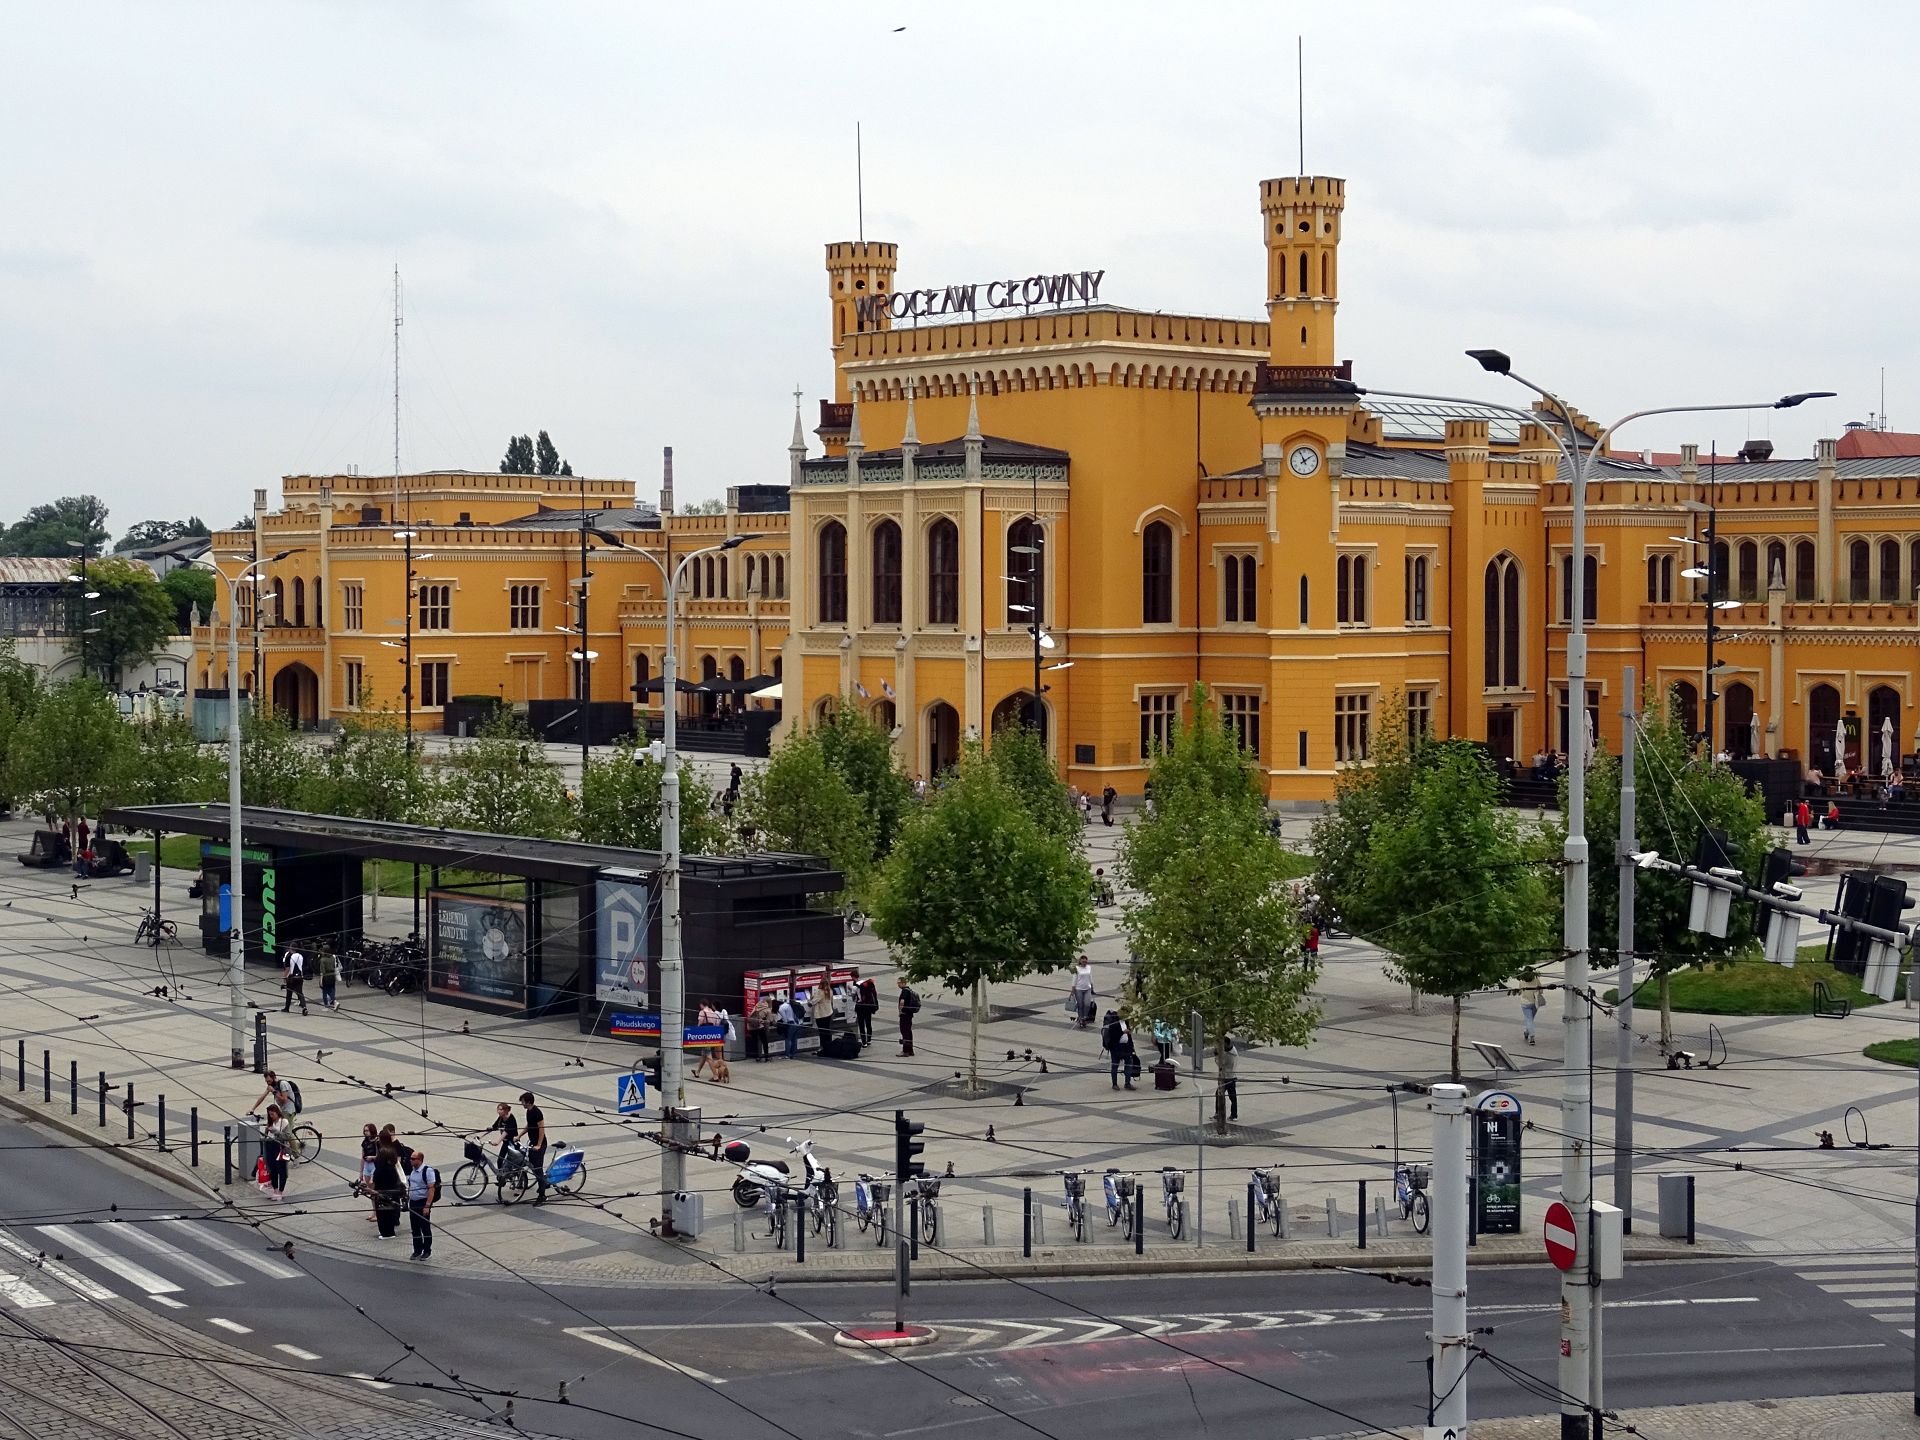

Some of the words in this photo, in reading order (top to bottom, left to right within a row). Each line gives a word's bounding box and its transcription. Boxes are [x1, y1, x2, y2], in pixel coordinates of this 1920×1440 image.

[854, 284, 977, 319] WROCŁAW
[987, 270, 1105, 308] GŁÓWNY
[253, 850, 269, 862] RUCH
[262, 868, 276, 954] RUCH
[438, 910, 468, 926] LEGENDA
[439, 925, 468, 941] LONDYNU
[611, 910, 634, 967] P
[615, 1020, 656, 1030] Piłsudskiego
[687, 1033, 721, 1041] Peronowa
